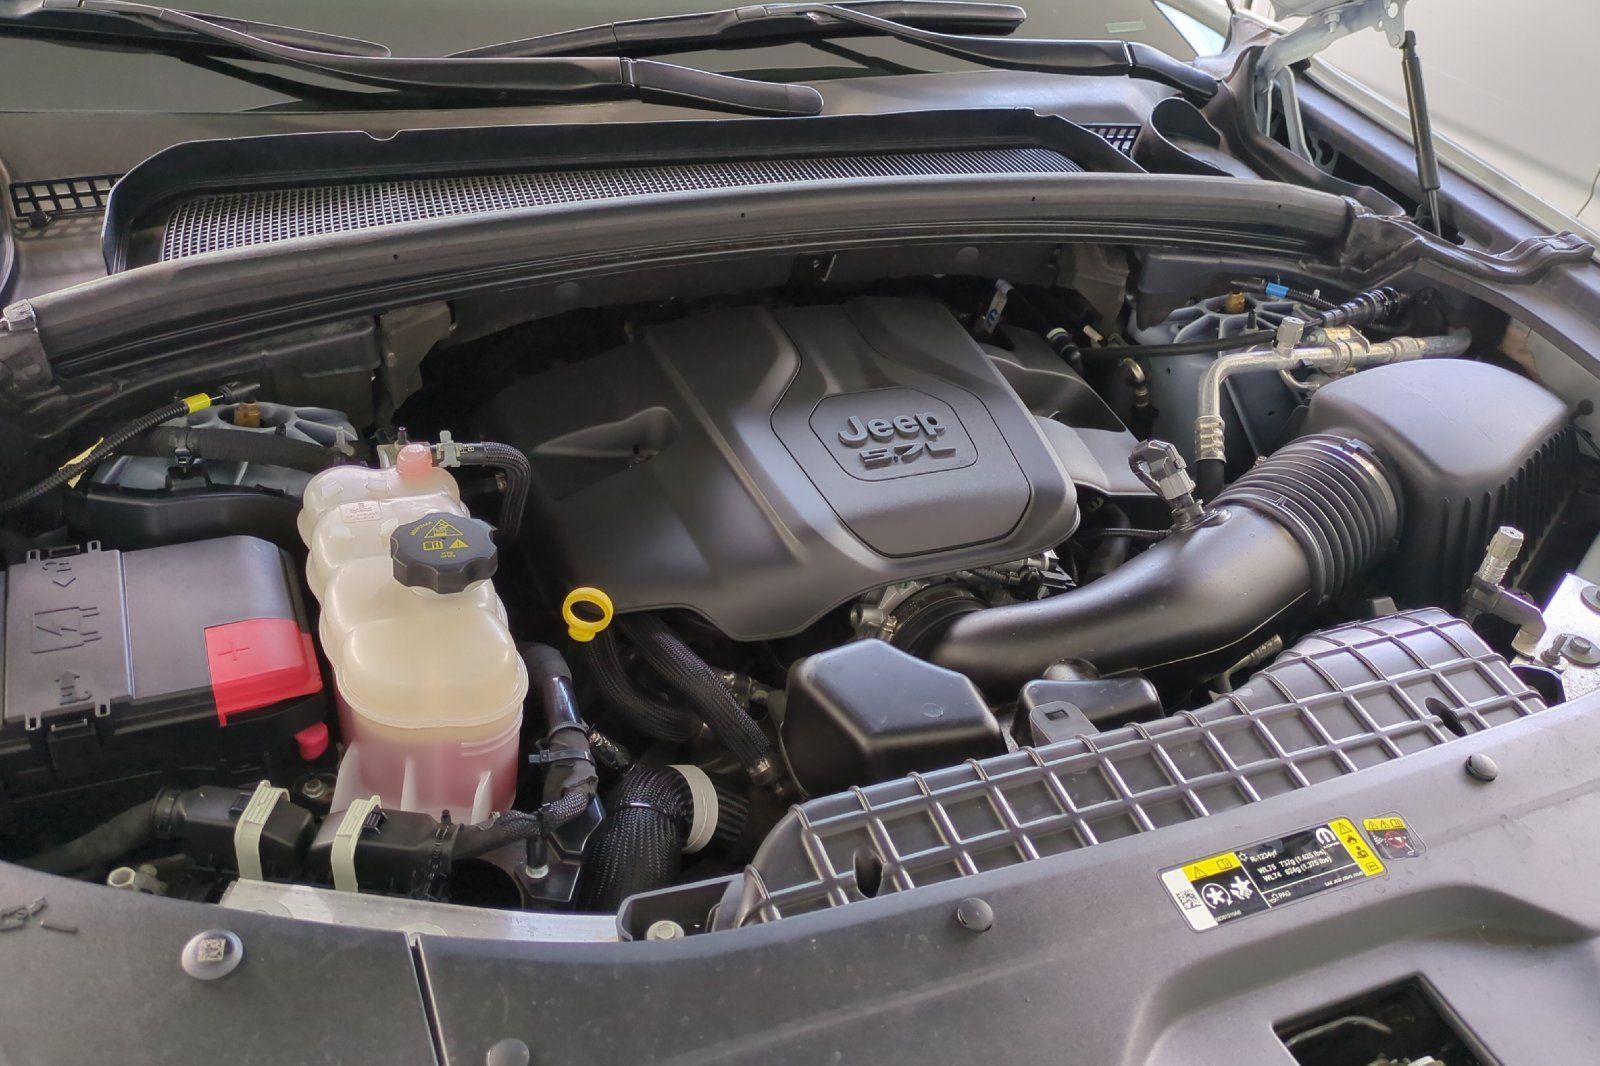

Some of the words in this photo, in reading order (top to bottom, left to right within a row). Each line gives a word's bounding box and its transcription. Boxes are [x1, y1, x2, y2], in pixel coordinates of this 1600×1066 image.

[838, 412, 946, 447] Jeep
[860, 441, 956, 470] 5.7L
[1249, 849, 1277, 862] R-1234yf
[1257, 863, 1277, 874] WL75
[1279, 857, 1296, 868] 737g
[1262, 871, 1282, 882] WL74
